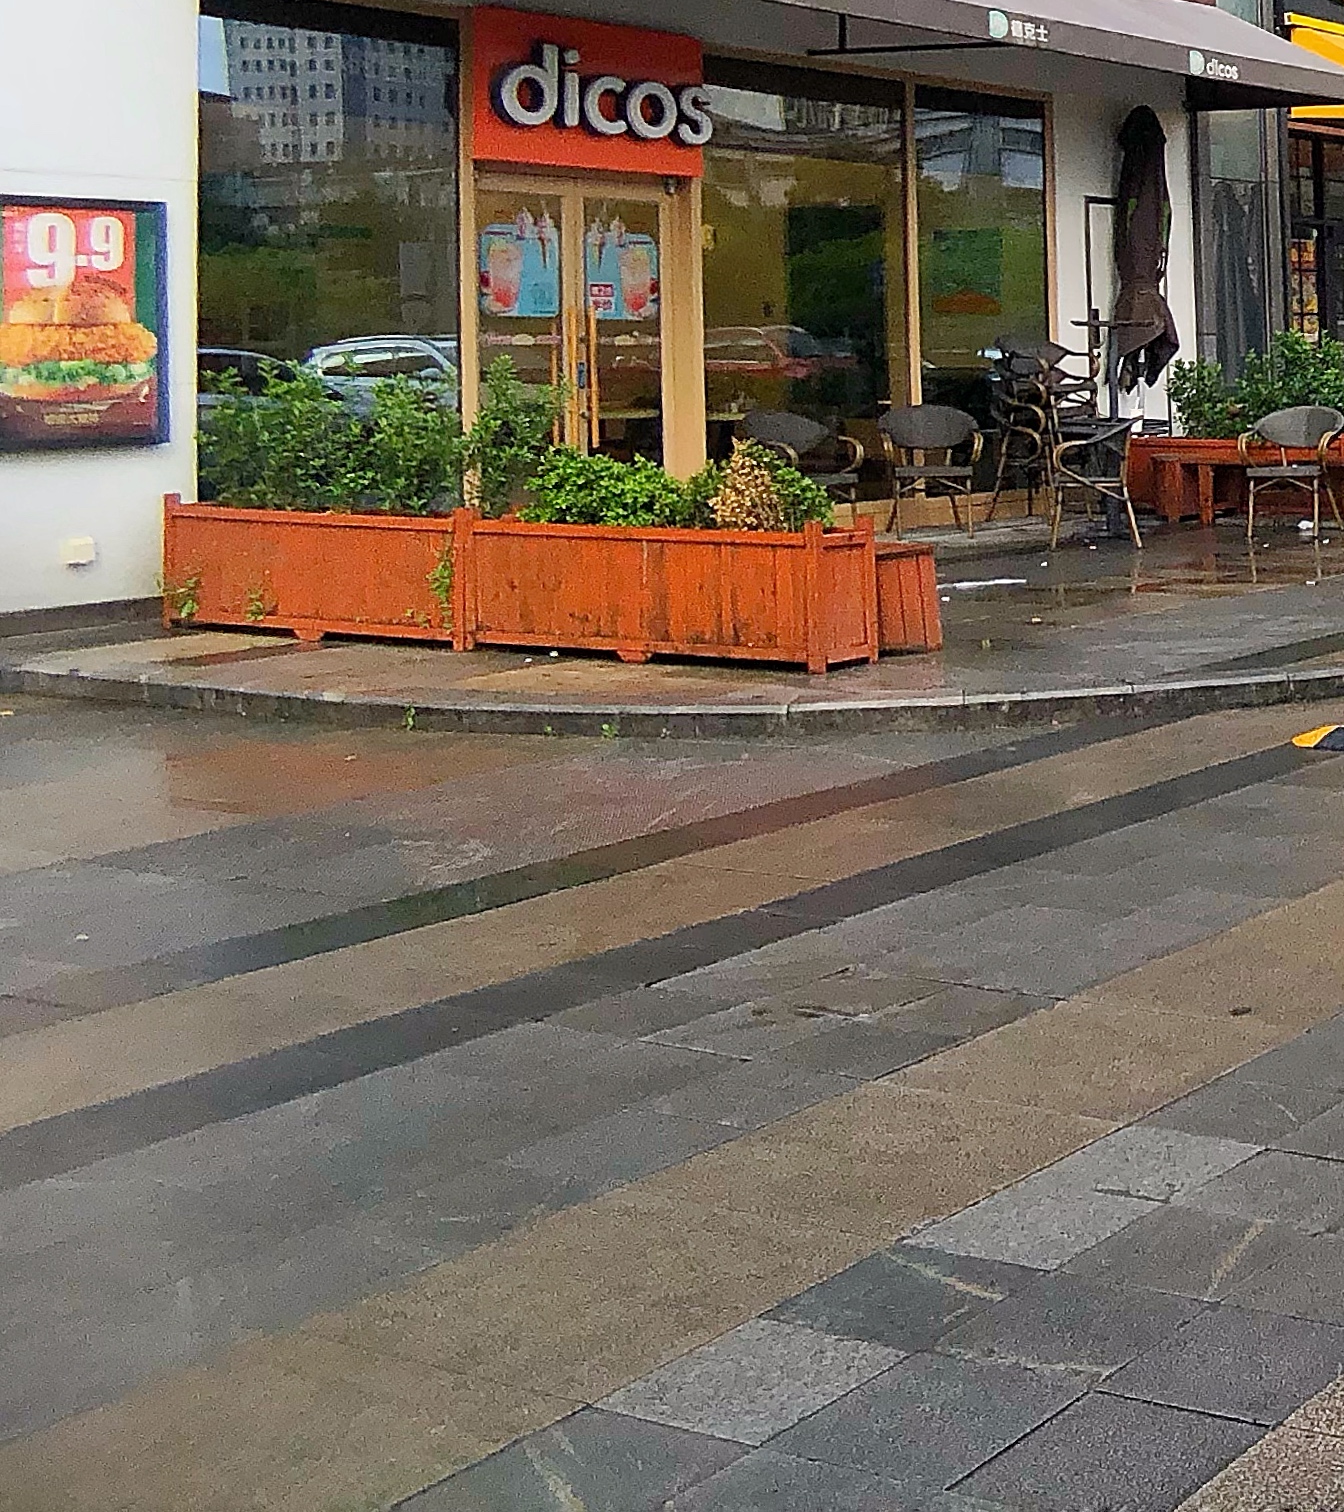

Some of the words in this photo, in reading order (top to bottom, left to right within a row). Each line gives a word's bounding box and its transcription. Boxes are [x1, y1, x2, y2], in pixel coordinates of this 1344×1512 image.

[1010, 20, 1049, 43] 德克士
[498, 42, 714, 146] dicos
[1205, 58, 1239, 80] dicos
[26, 211, 125, 288] 9.9
